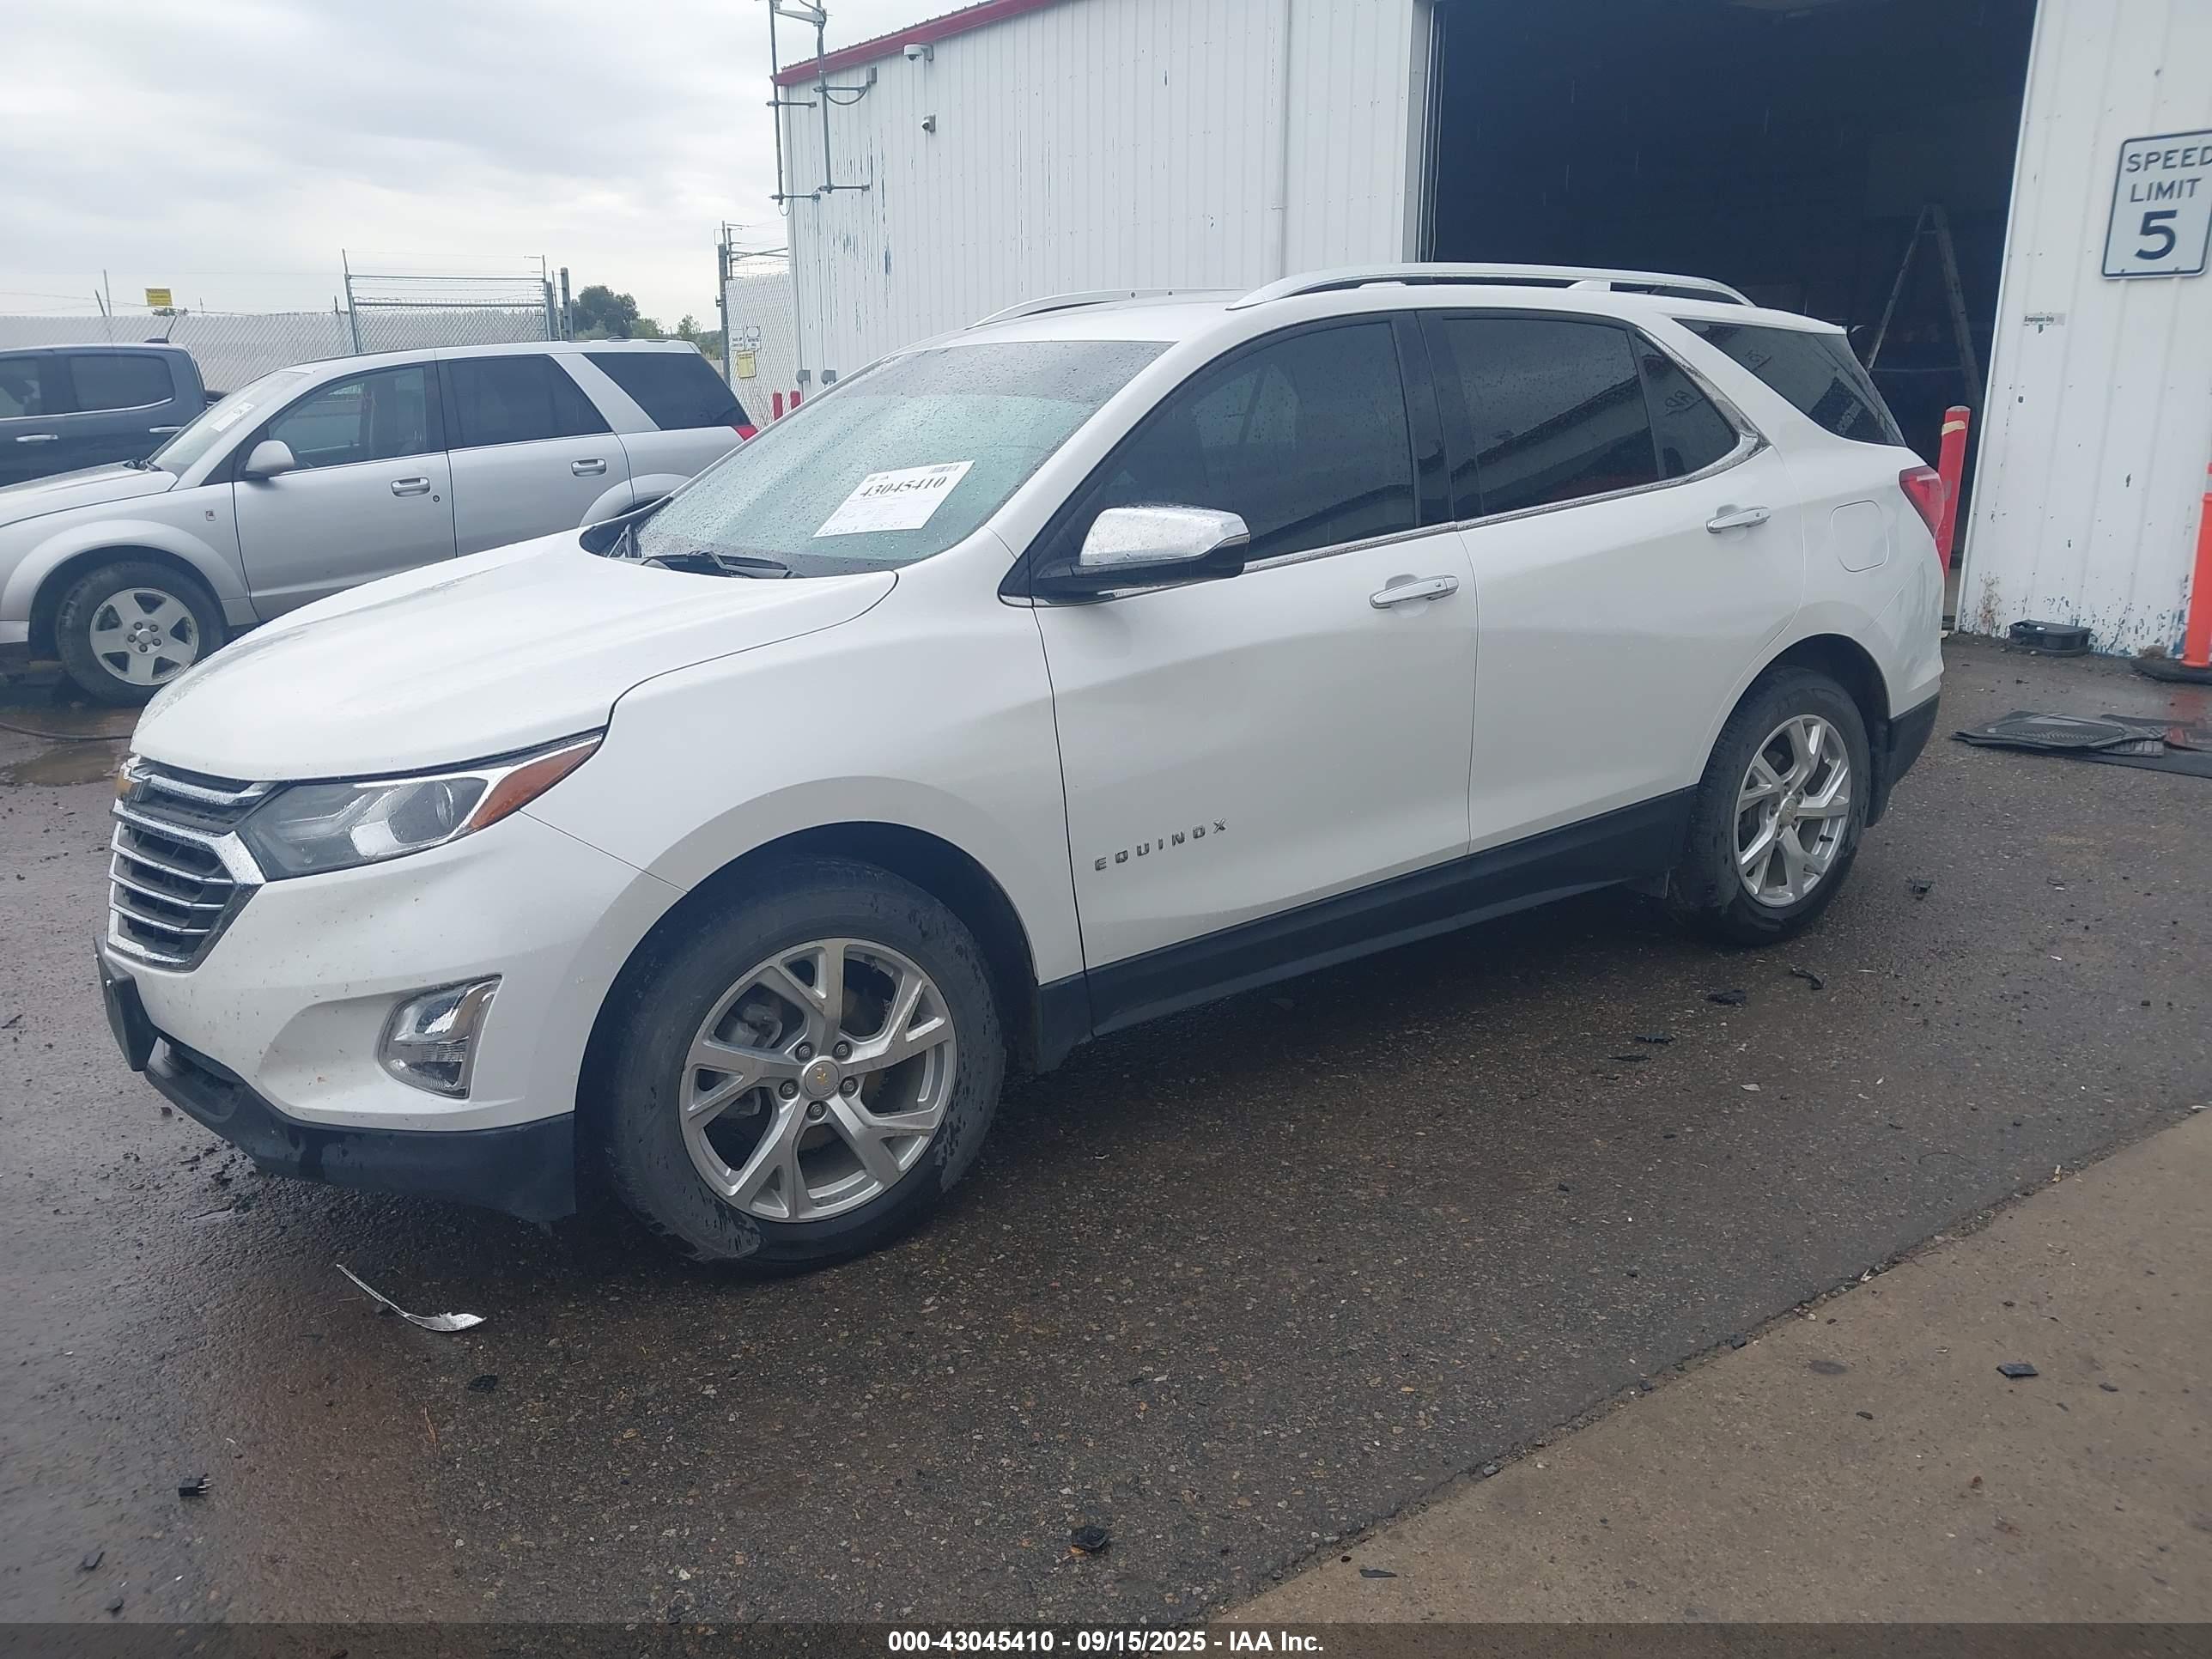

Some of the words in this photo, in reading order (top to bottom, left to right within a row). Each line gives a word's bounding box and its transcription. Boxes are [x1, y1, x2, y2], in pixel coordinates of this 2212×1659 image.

[2125, 145, 2212, 173] SPEED
[2130, 178, 2202, 203] LIMIT
[2135, 210, 2178, 260] 5
[860, 476, 948, 497] 43045410
[1094, 817, 1227, 872] EQUINOX
